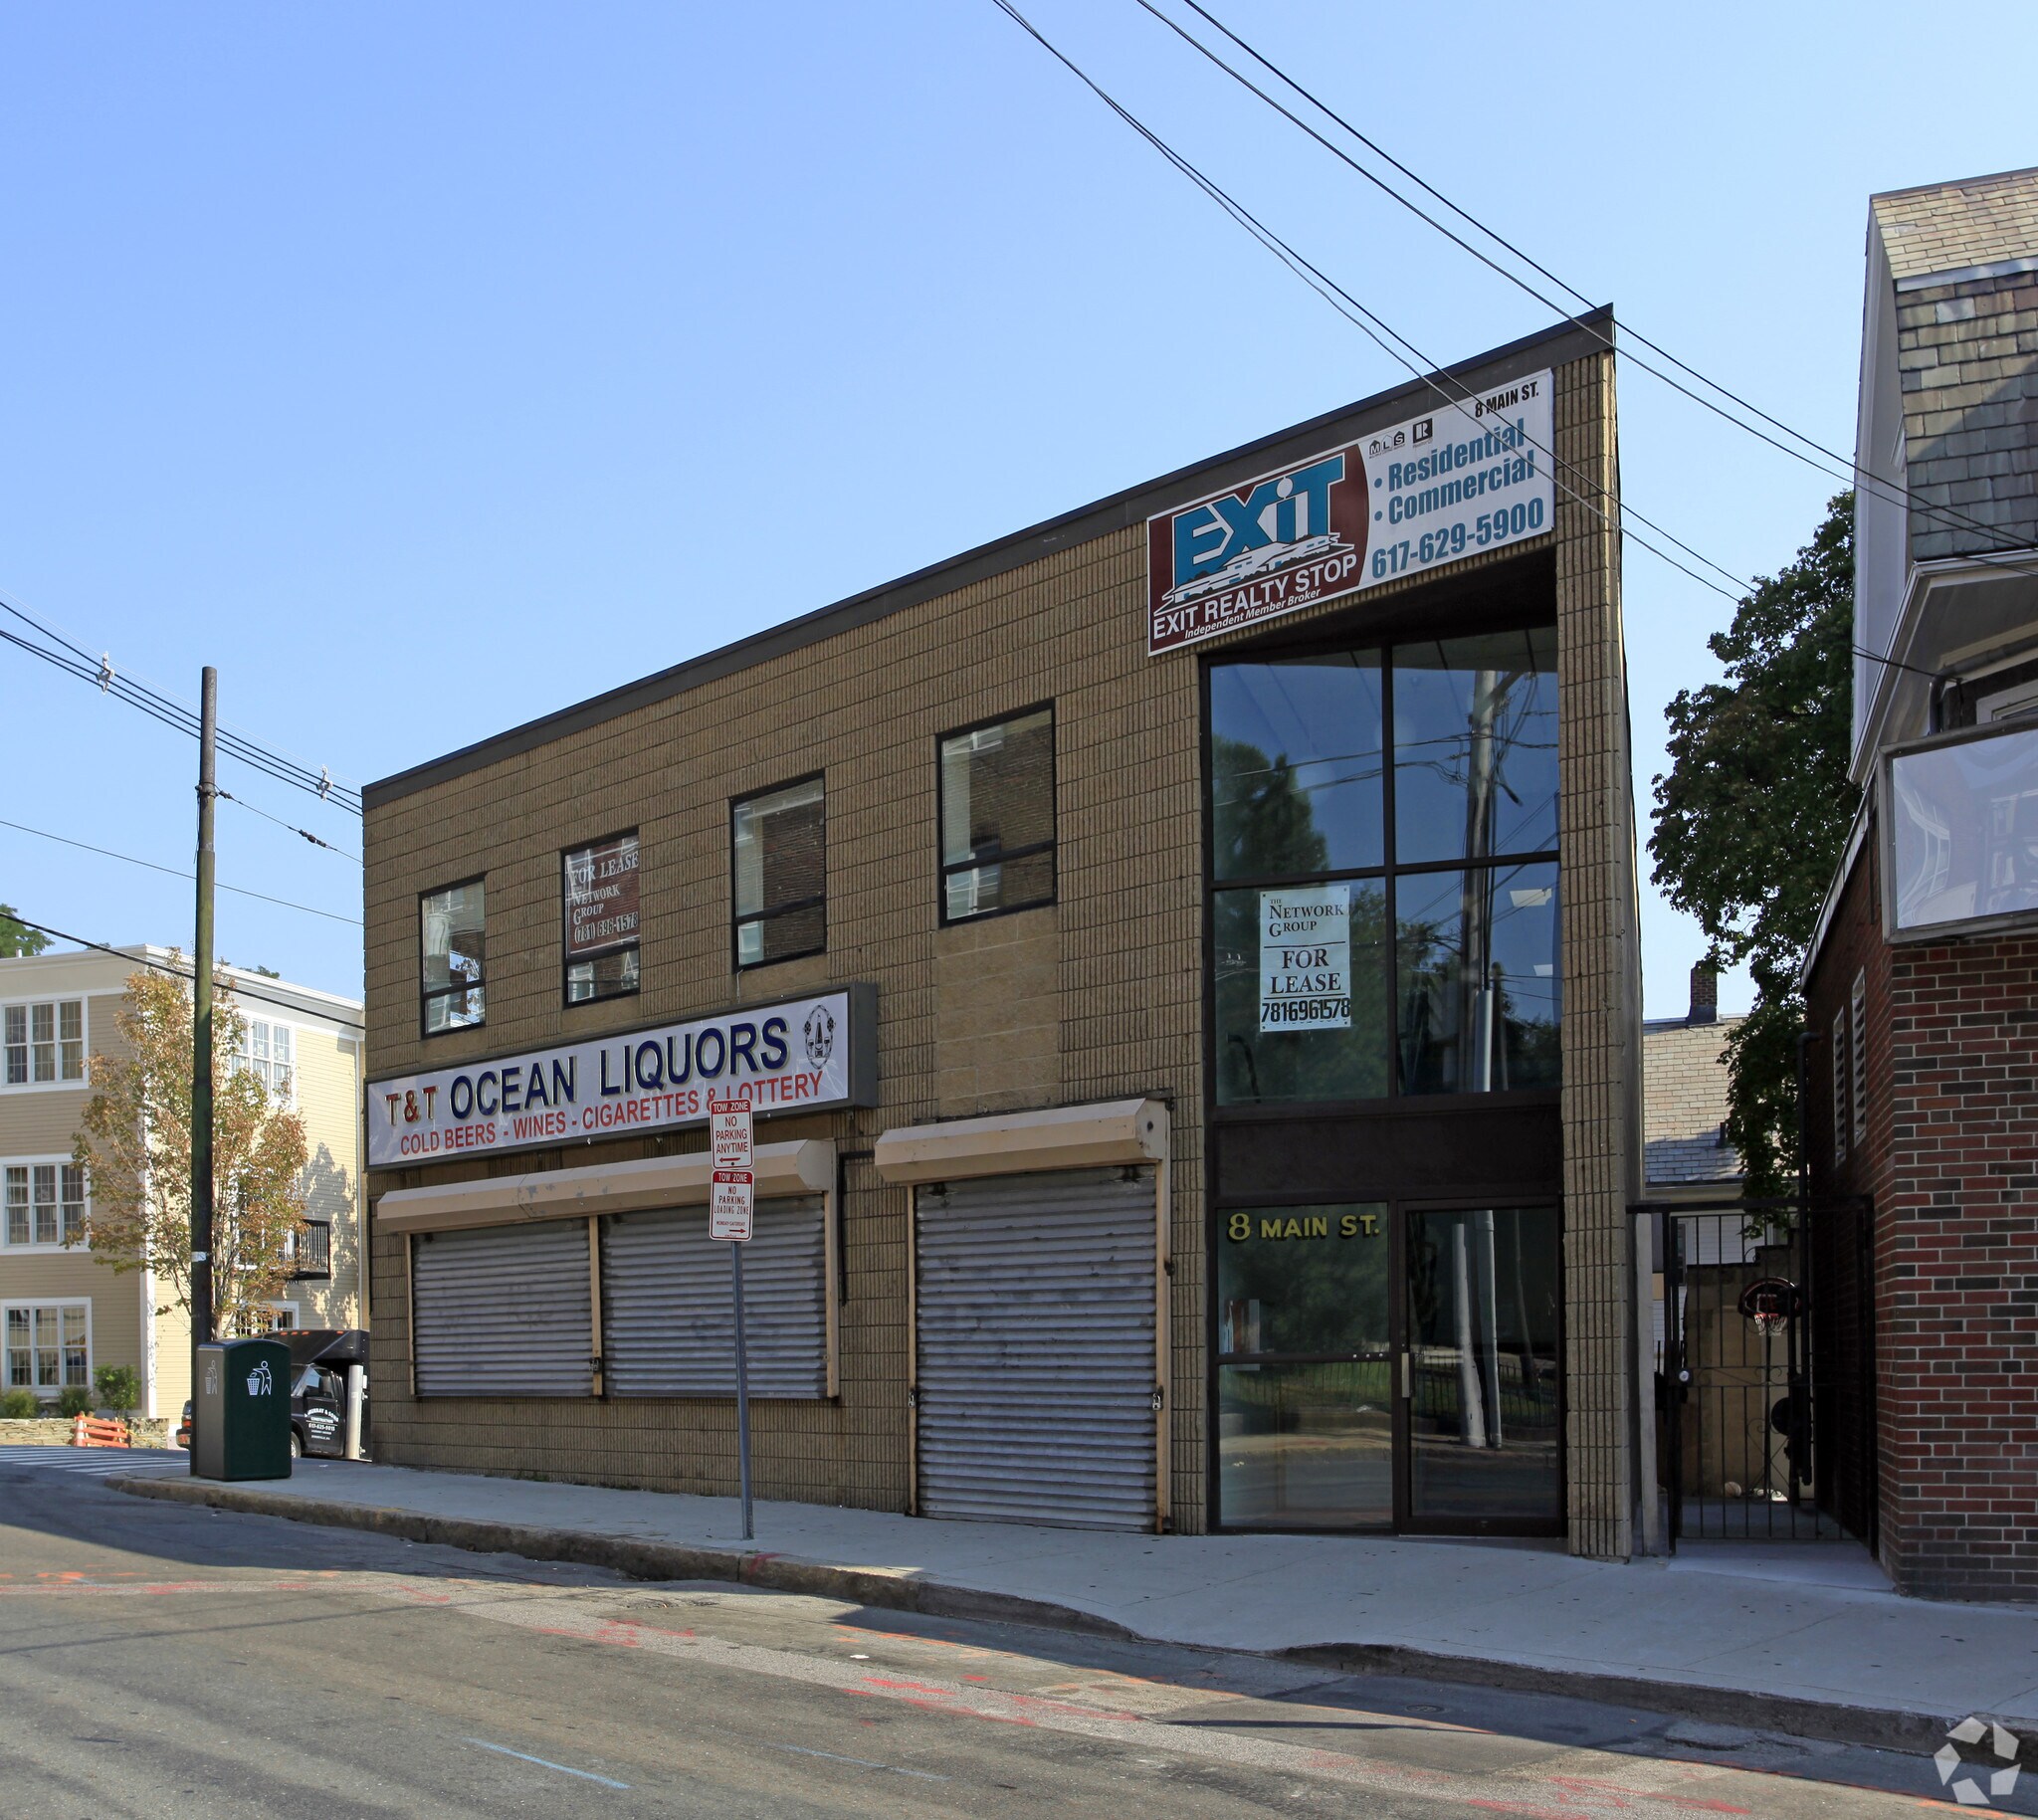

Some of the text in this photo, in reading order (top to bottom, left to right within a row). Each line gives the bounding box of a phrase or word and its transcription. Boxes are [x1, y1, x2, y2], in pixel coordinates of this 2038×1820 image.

[1475, 381, 1539, 418] 8 MAIN ST.
[1388, 417, 1525, 492] Residential
[1388, 449, 1534, 524] Commercial
[1372, 498, 1544, 578] 617-629-5900
[1153, 553, 1357, 639] EXIT REALTY STOP
[1184, 588, 1322, 639] Independent Member Broker
[570, 851, 639, 887] FOR LEASE
[574, 921, 595, 943] (781)
[1282, 948, 1329, 969] FOR
[1270, 972, 1341, 994] LEASE
[450, 1056, 577, 1119] OCEAN
[599, 1016, 790, 1097] LIQUORS
[713, 1102, 748, 1112] TOW ZONE
[400, 1130, 440, 1155] COLD
[445, 1121, 496, 1150] BEERS
[512, 1111, 566, 1139] WINES
[582, 1090, 699, 1130] CIGARETTES
[724, 1115, 737, 1126] NO
[715, 1128, 747, 1140] PARKING
[715, 1142, 748, 1153] ANYTIME
[718, 1172, 747, 1182] TOW ZONE
[718, 1195, 745, 1205] PARKING
[727, 1185, 736, 1194] NO
[713, 1205, 748, 1215] LOADING ZONE
[1227, 1212, 1380, 1241] 8 MAIN ST.
